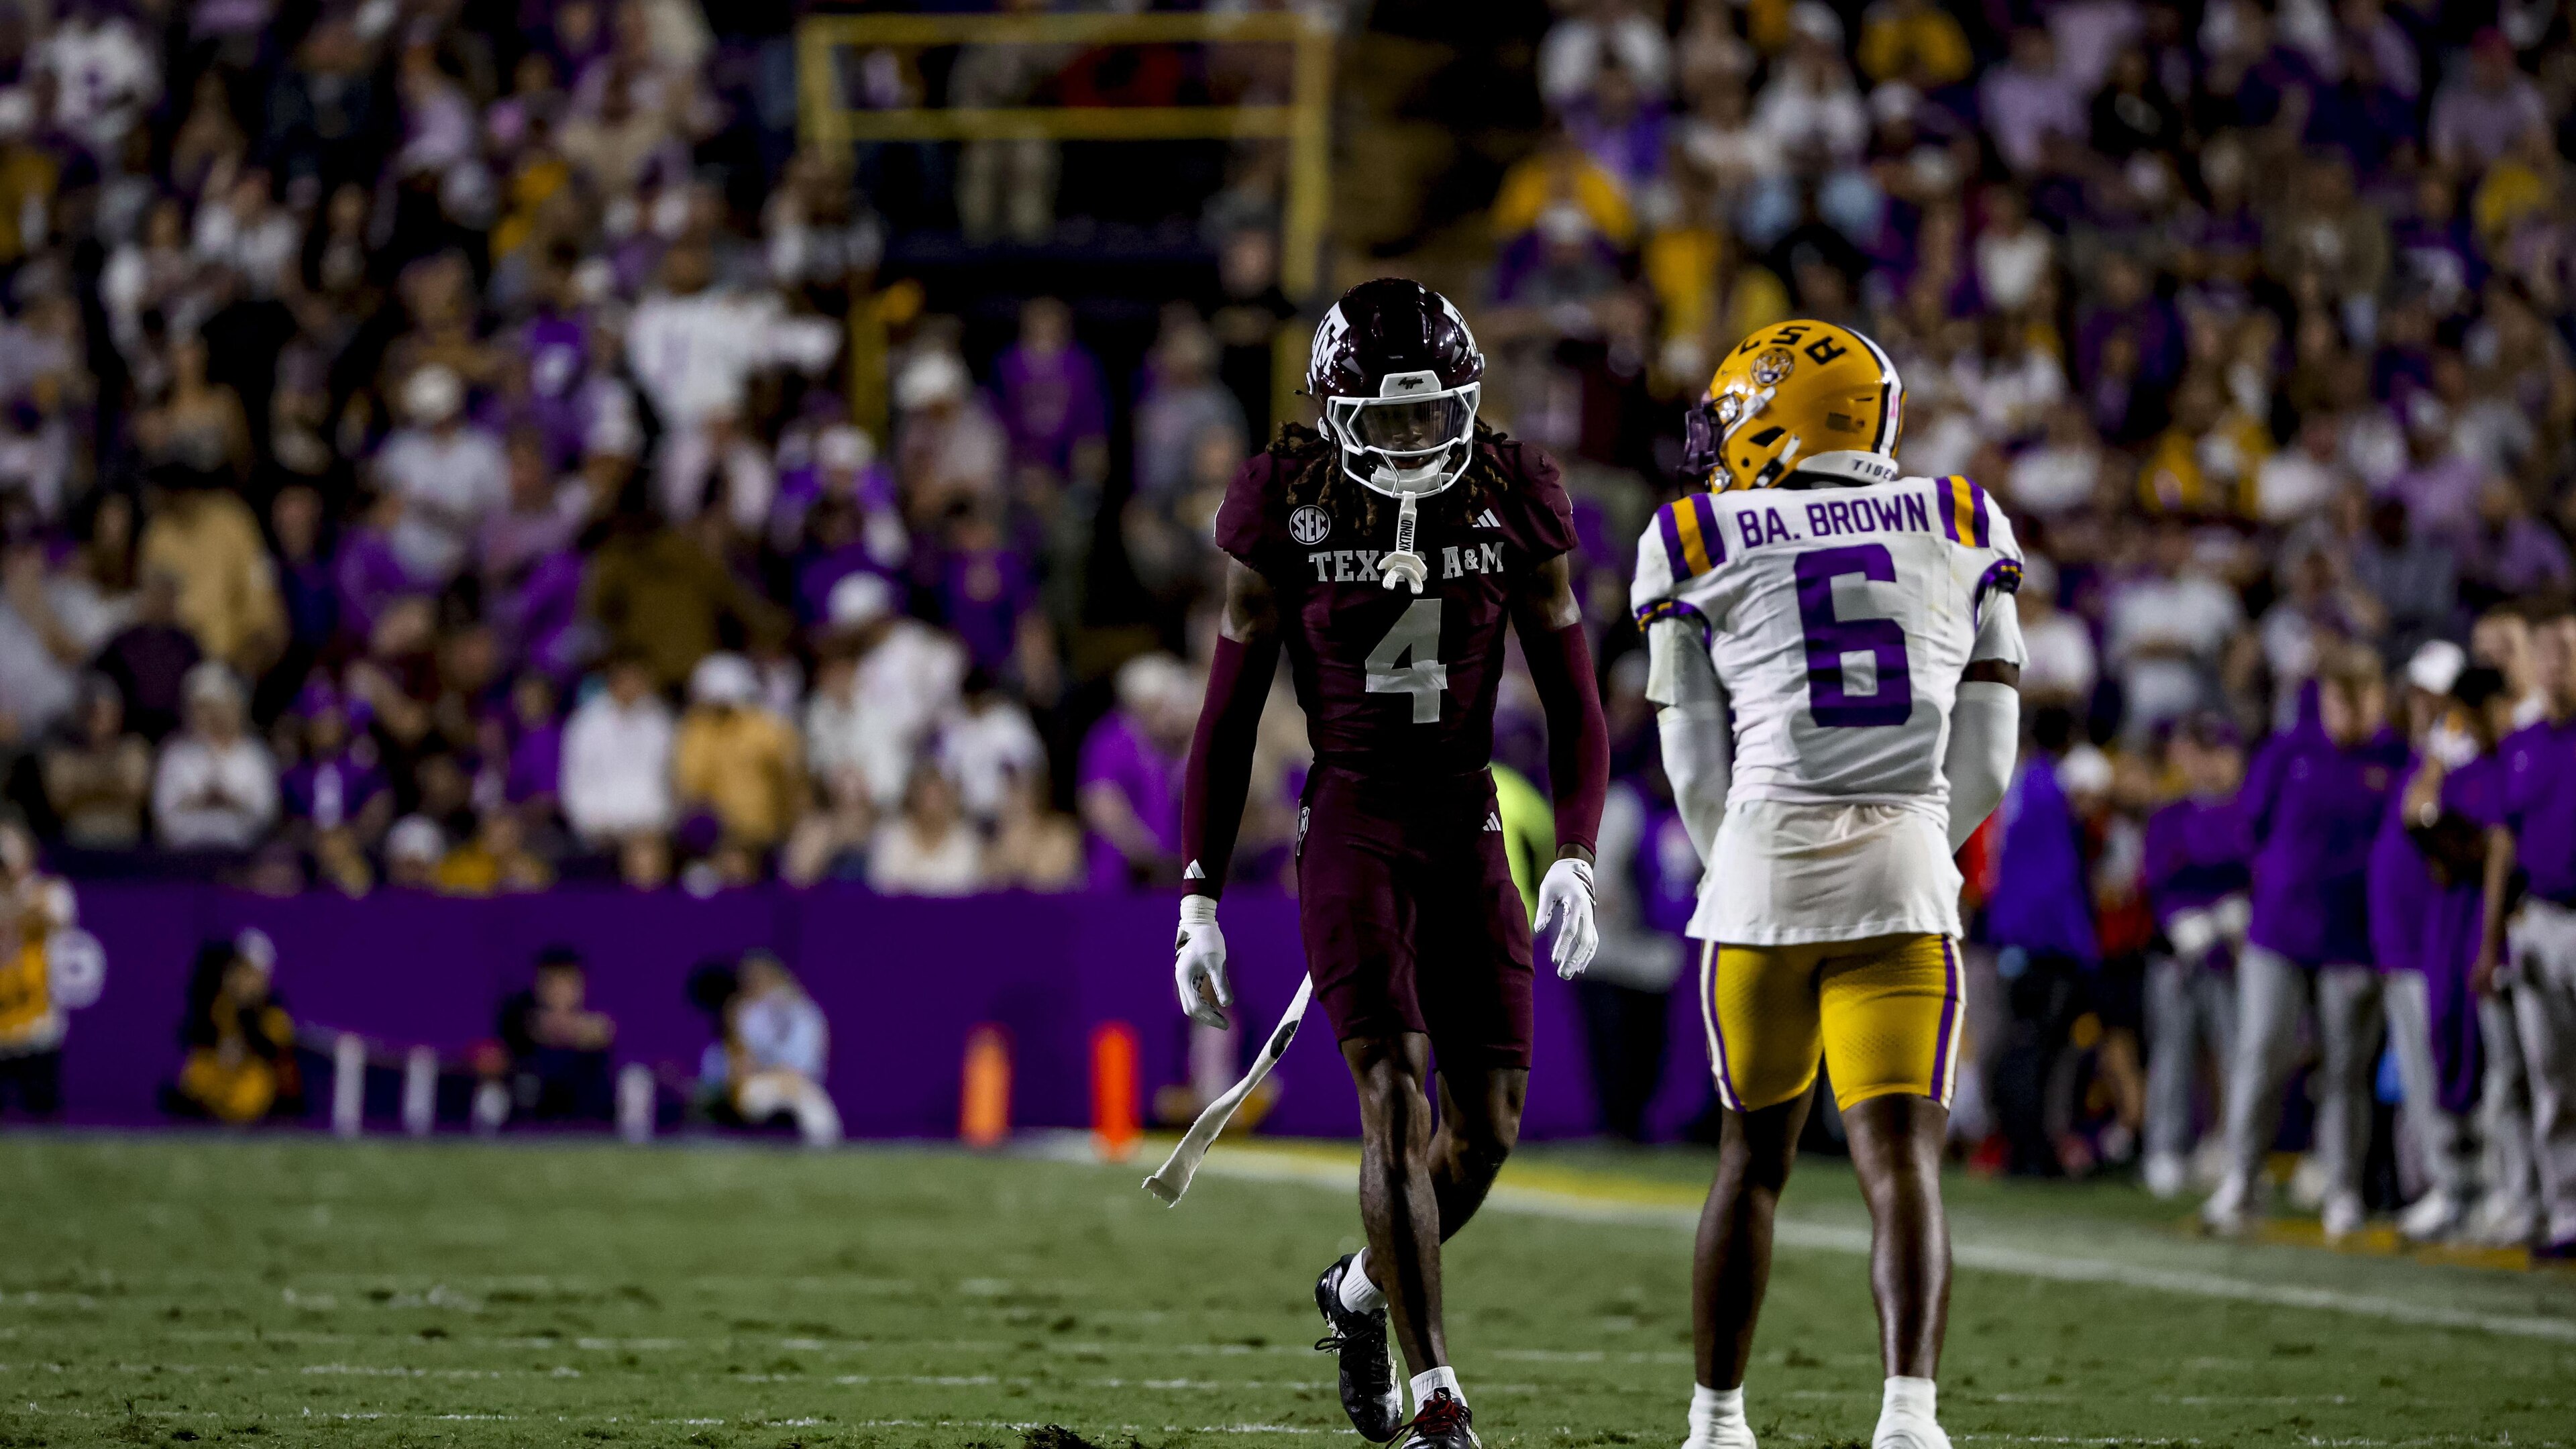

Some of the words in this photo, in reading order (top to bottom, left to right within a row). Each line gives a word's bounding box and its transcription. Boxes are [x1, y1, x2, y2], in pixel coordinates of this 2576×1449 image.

[1293, 508, 1326, 542] SEC
[1399, 519, 1413, 553] NXTRND
[1736, 506, 1801, 549] BA.
[1806, 492, 1930, 538] BROWN
[1308, 549, 1428, 582] TEX
[1442, 541, 1505, 580] A&M
[1794, 543, 1912, 727] 6
[1365, 598, 1448, 724] 4
